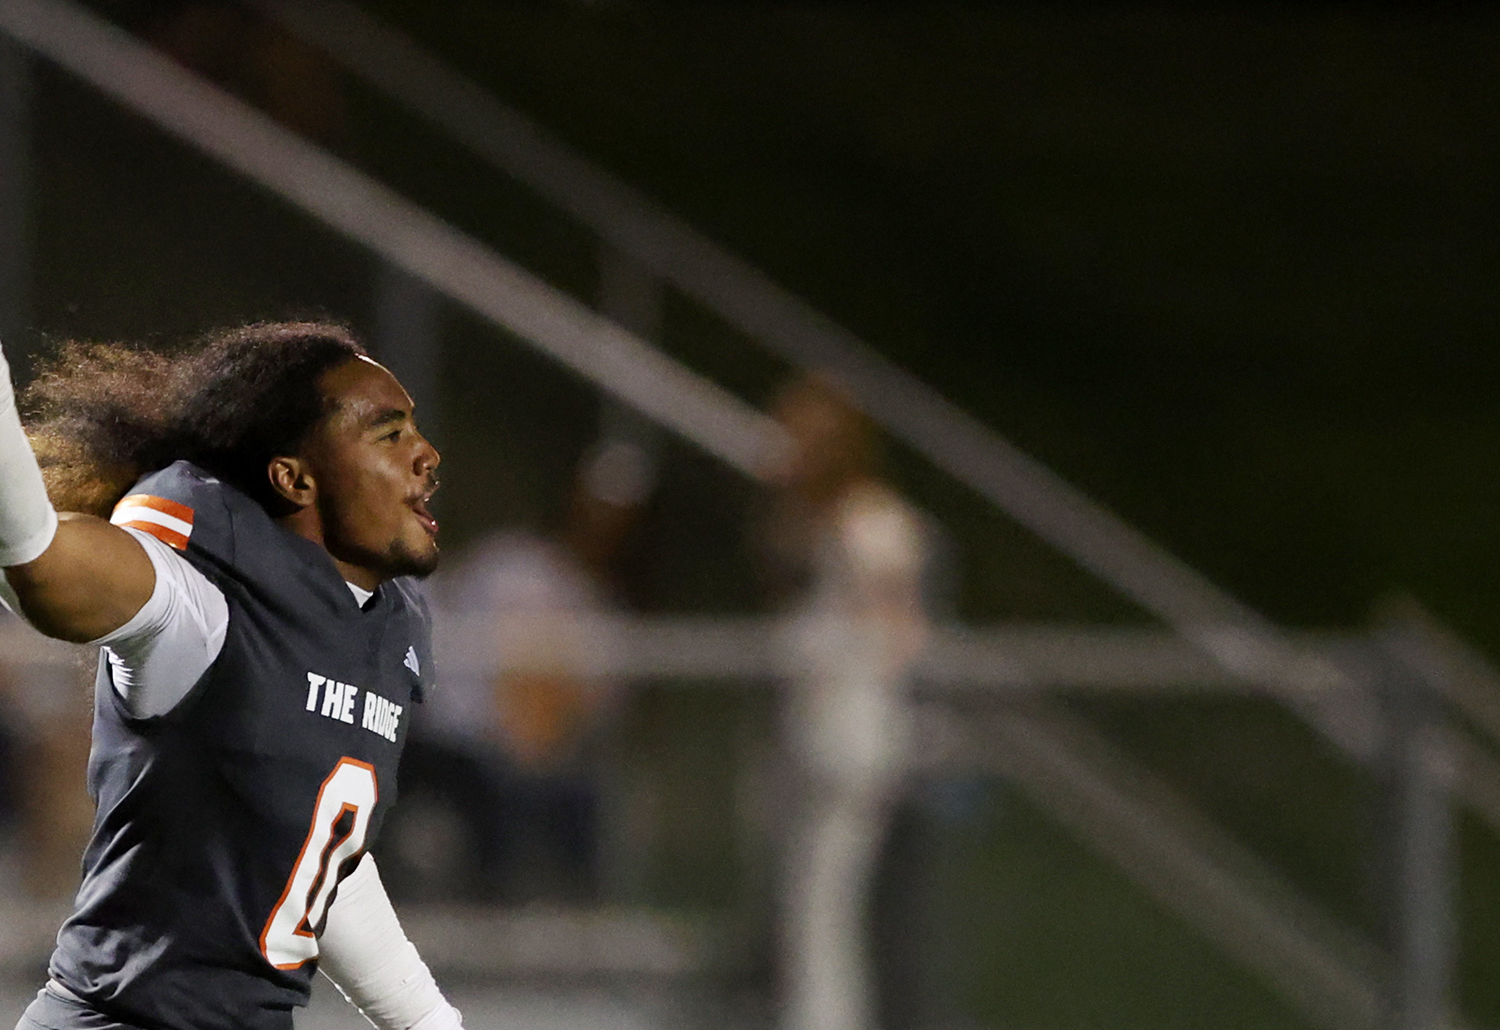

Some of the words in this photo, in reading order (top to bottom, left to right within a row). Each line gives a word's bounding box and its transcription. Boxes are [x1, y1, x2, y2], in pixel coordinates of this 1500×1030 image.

[305, 671, 359, 725] THE
[361, 691, 403, 743] RIDGE
[259, 756, 378, 970] 0
